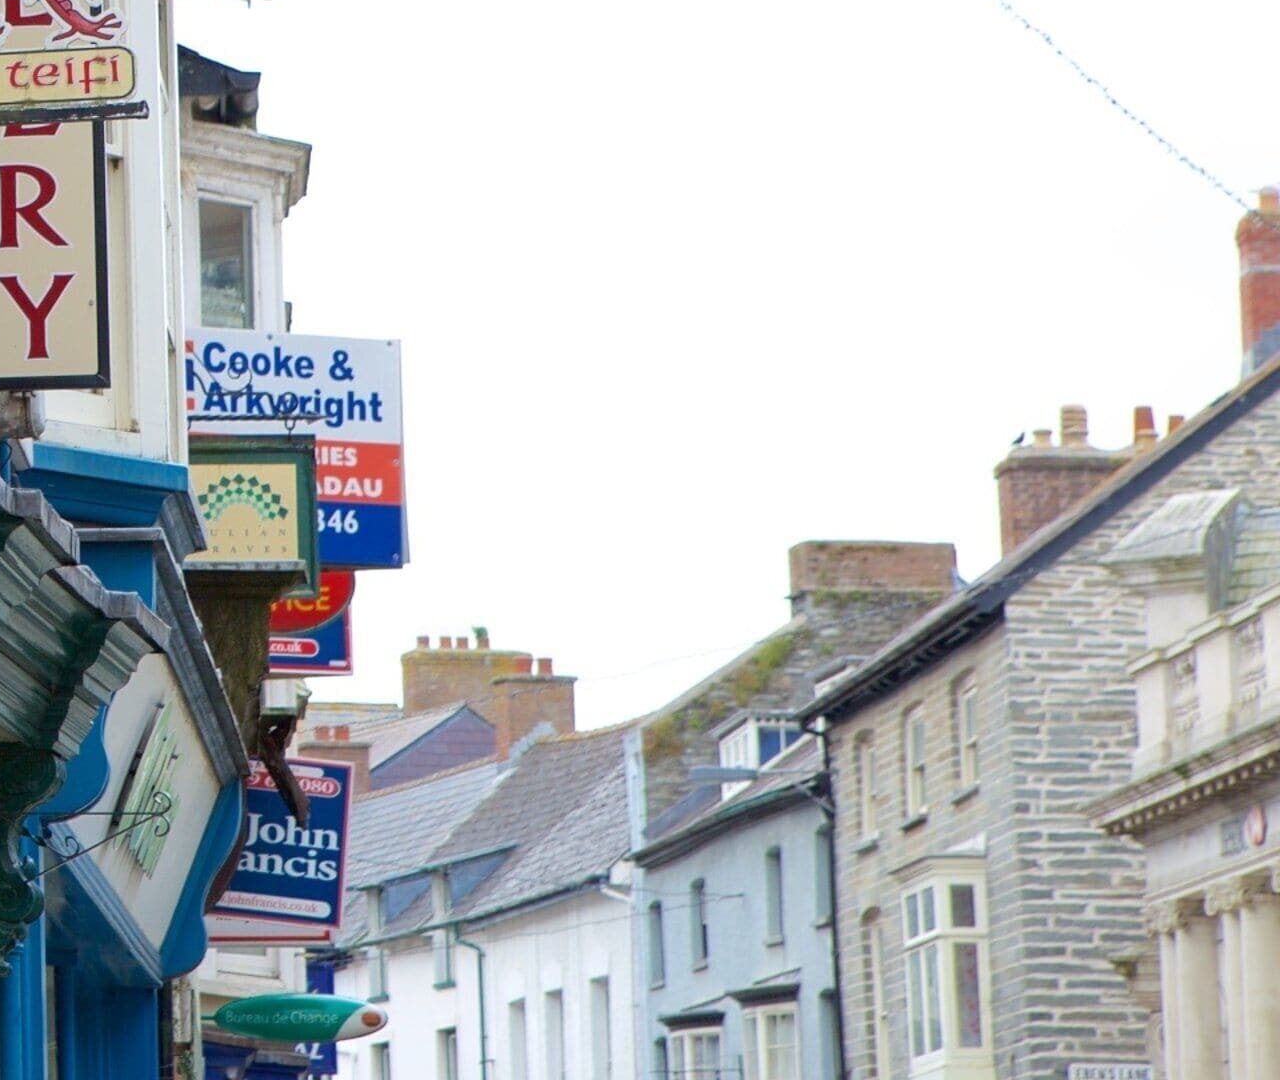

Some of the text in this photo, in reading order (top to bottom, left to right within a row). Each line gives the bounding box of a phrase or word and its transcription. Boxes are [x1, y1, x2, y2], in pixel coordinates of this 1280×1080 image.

[6, 54, 120, 95] teifi
[202, 341, 355, 381] Cooke &
[203, 381, 383, 428] Arkwright
[245, 813, 340, 851] John
[225, 1010, 339, 1027] Bureau de Change
